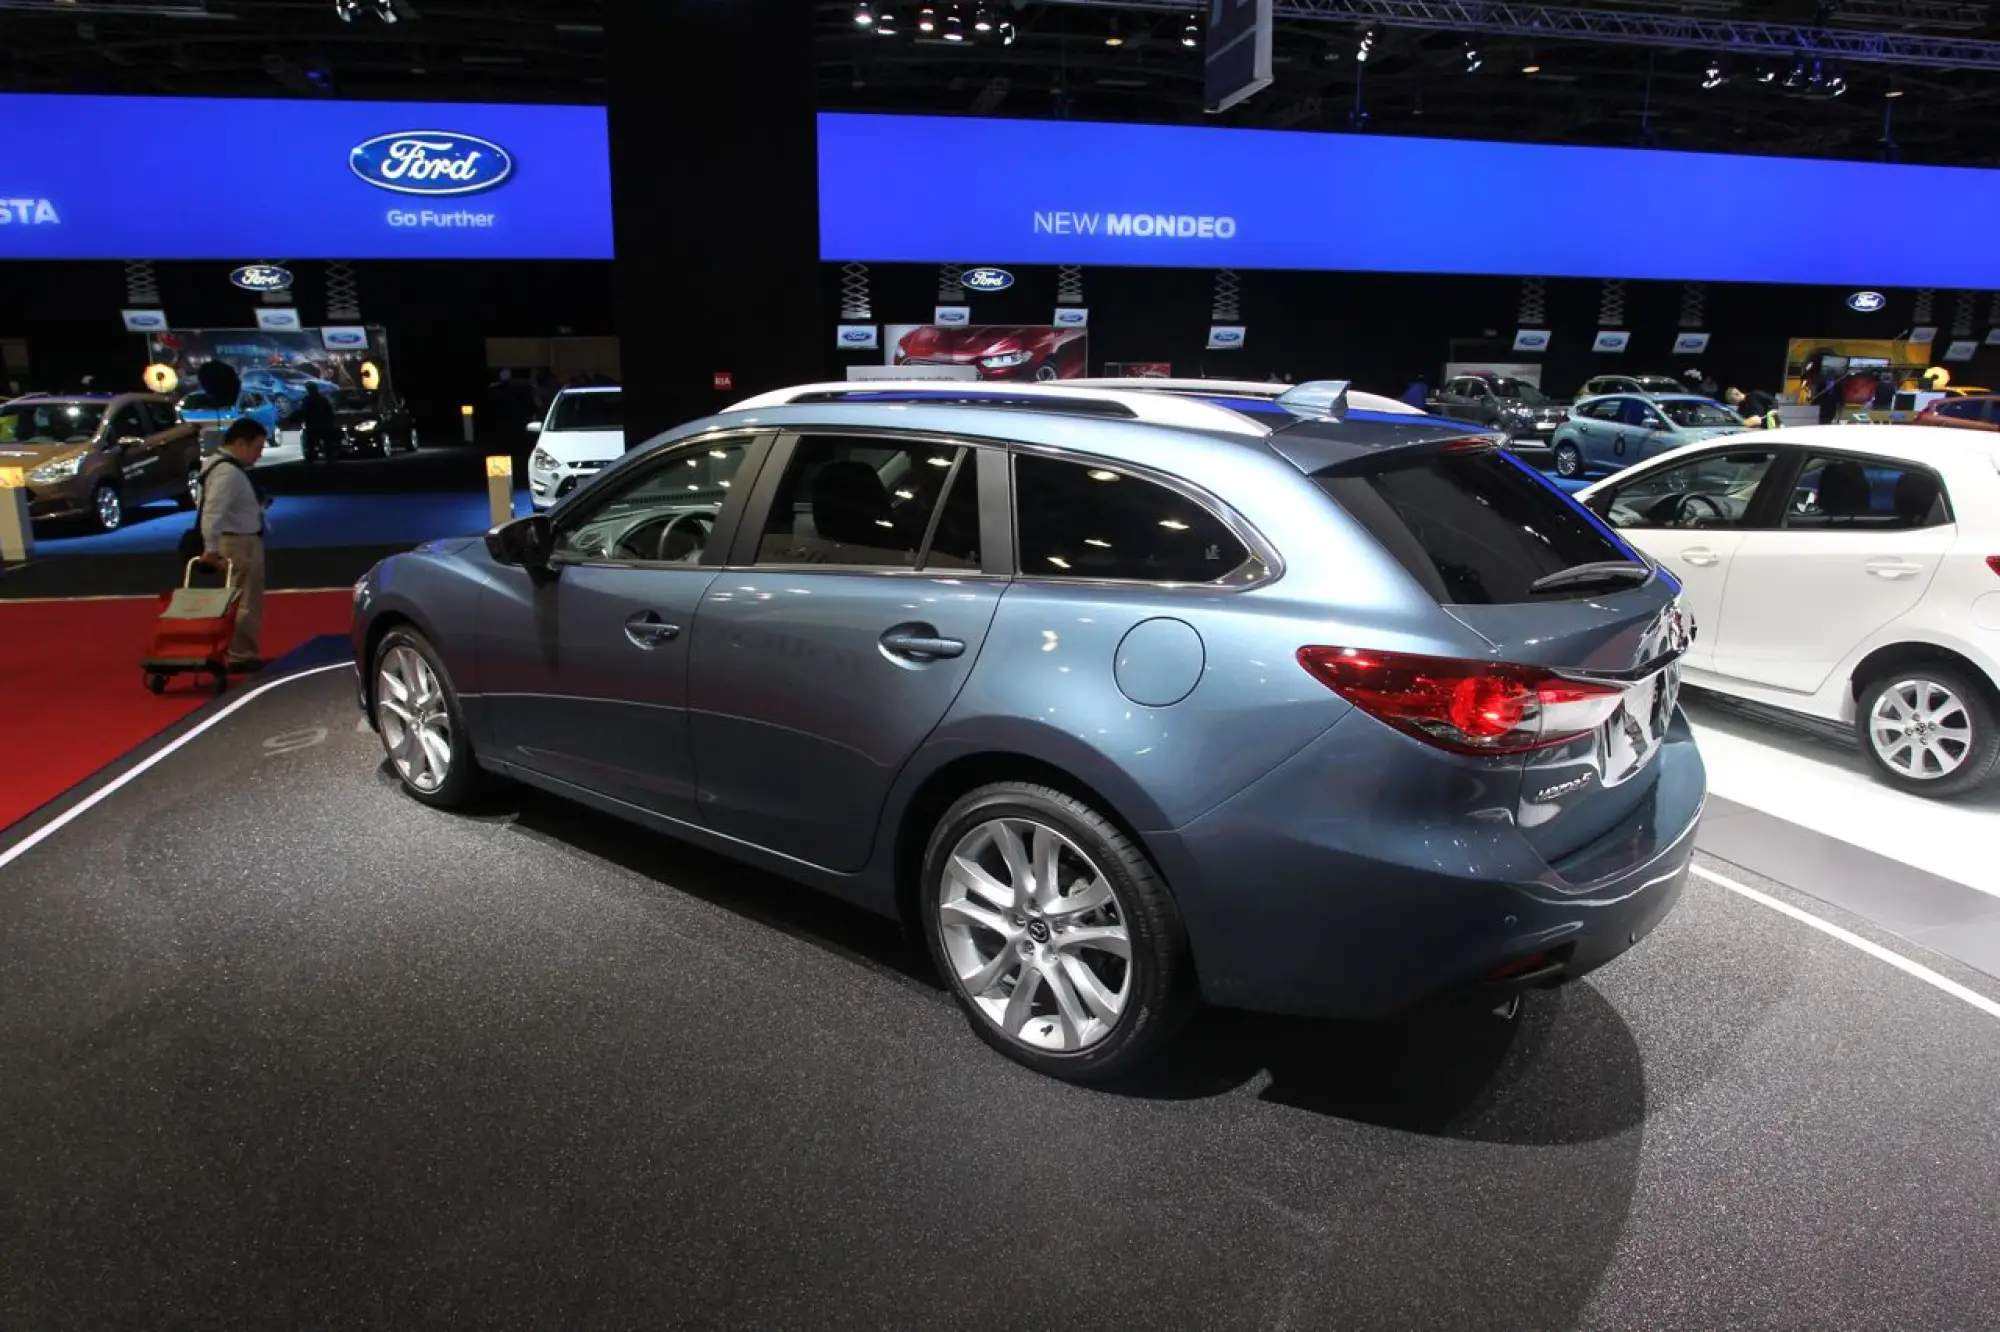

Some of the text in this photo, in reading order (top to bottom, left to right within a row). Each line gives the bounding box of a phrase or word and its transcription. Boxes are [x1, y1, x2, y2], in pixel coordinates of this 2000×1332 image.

[381, 140, 479, 180] Ford
[387, 210, 495, 227] Go Further
[1034, 211, 1236, 239] NEW MONDEO
[241, 269, 280, 285] Ford
[971, 271, 1004, 286] Ford
